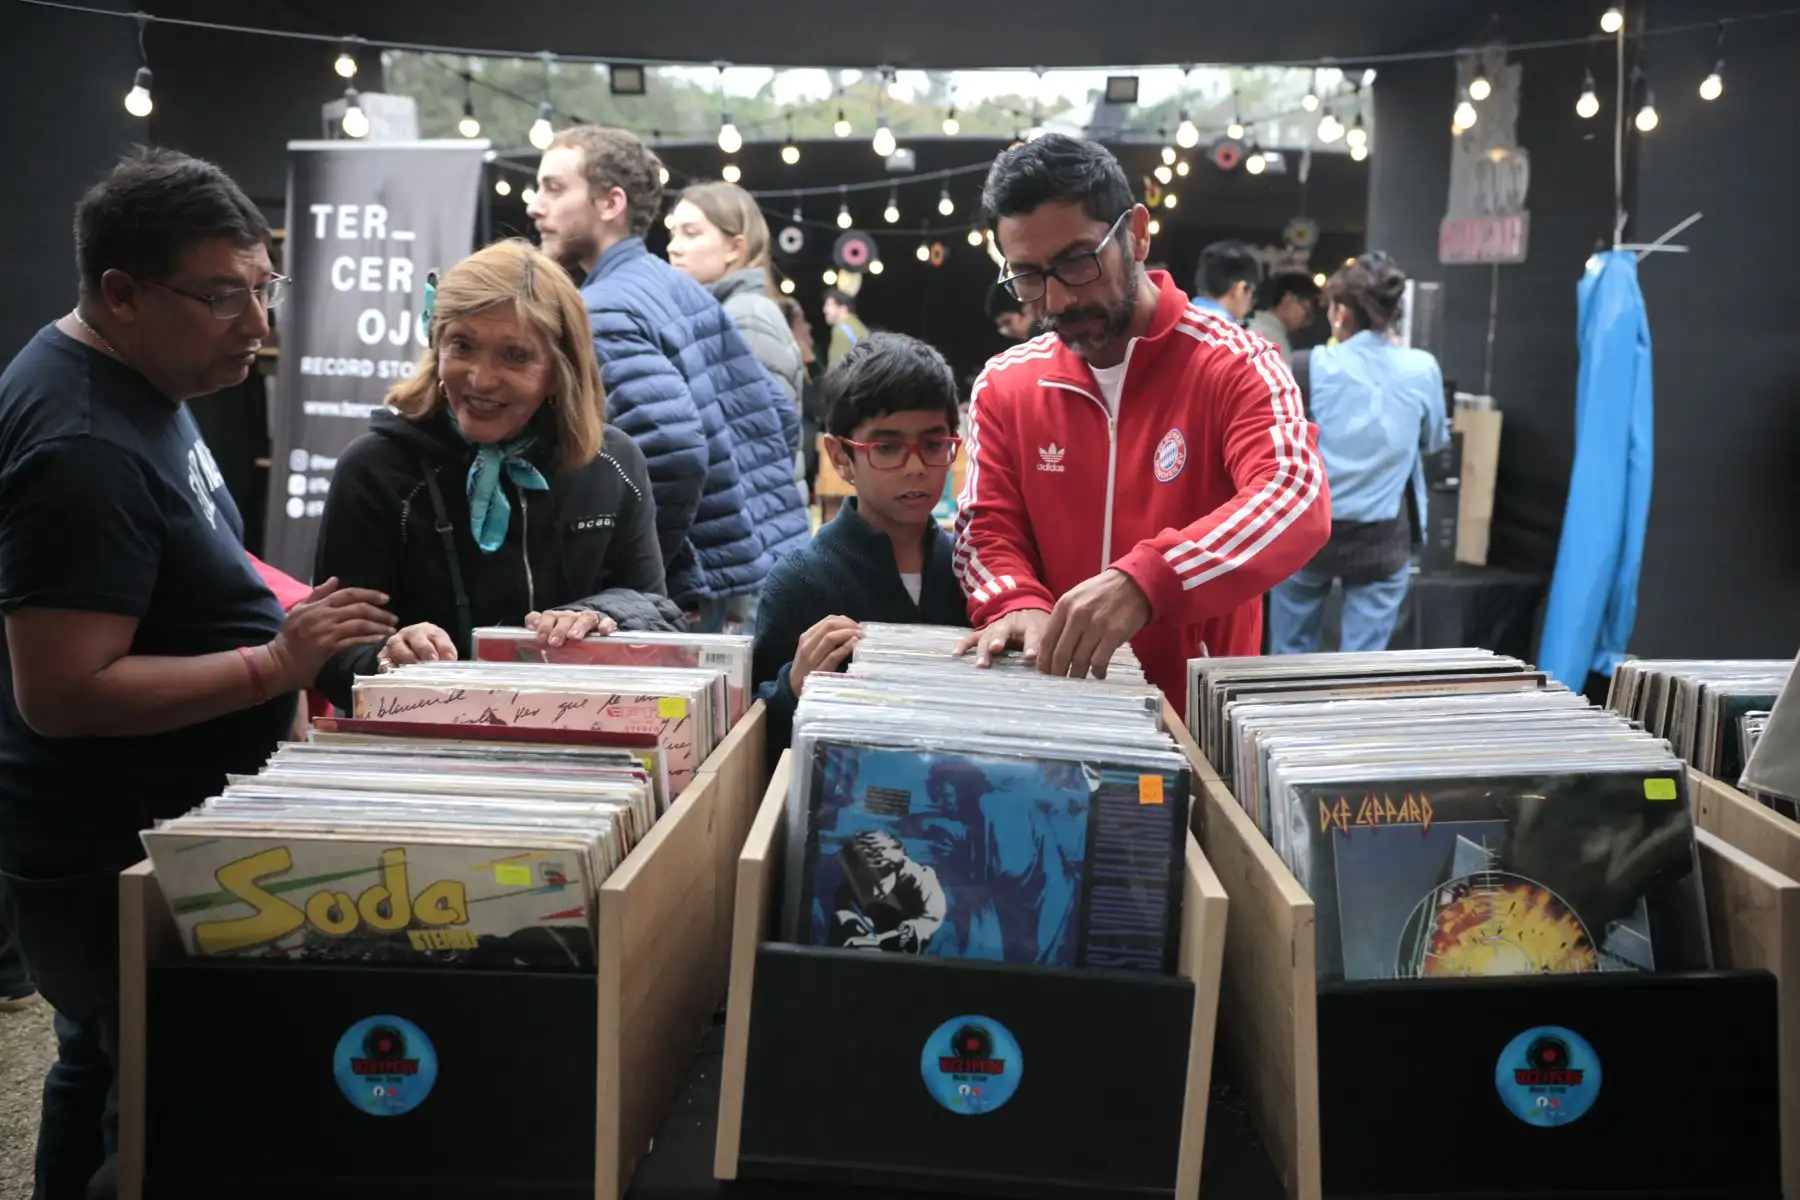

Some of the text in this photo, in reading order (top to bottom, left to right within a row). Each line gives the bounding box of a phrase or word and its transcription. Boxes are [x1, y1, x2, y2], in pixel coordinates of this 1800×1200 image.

[310, 204, 416, 240] TER_
[331, 256, 414, 293] CER
[301, 356, 416, 378] RECORD STO
[1319, 790, 1434, 836] DEF LEPPARD
[194, 845, 470, 957] Soda
